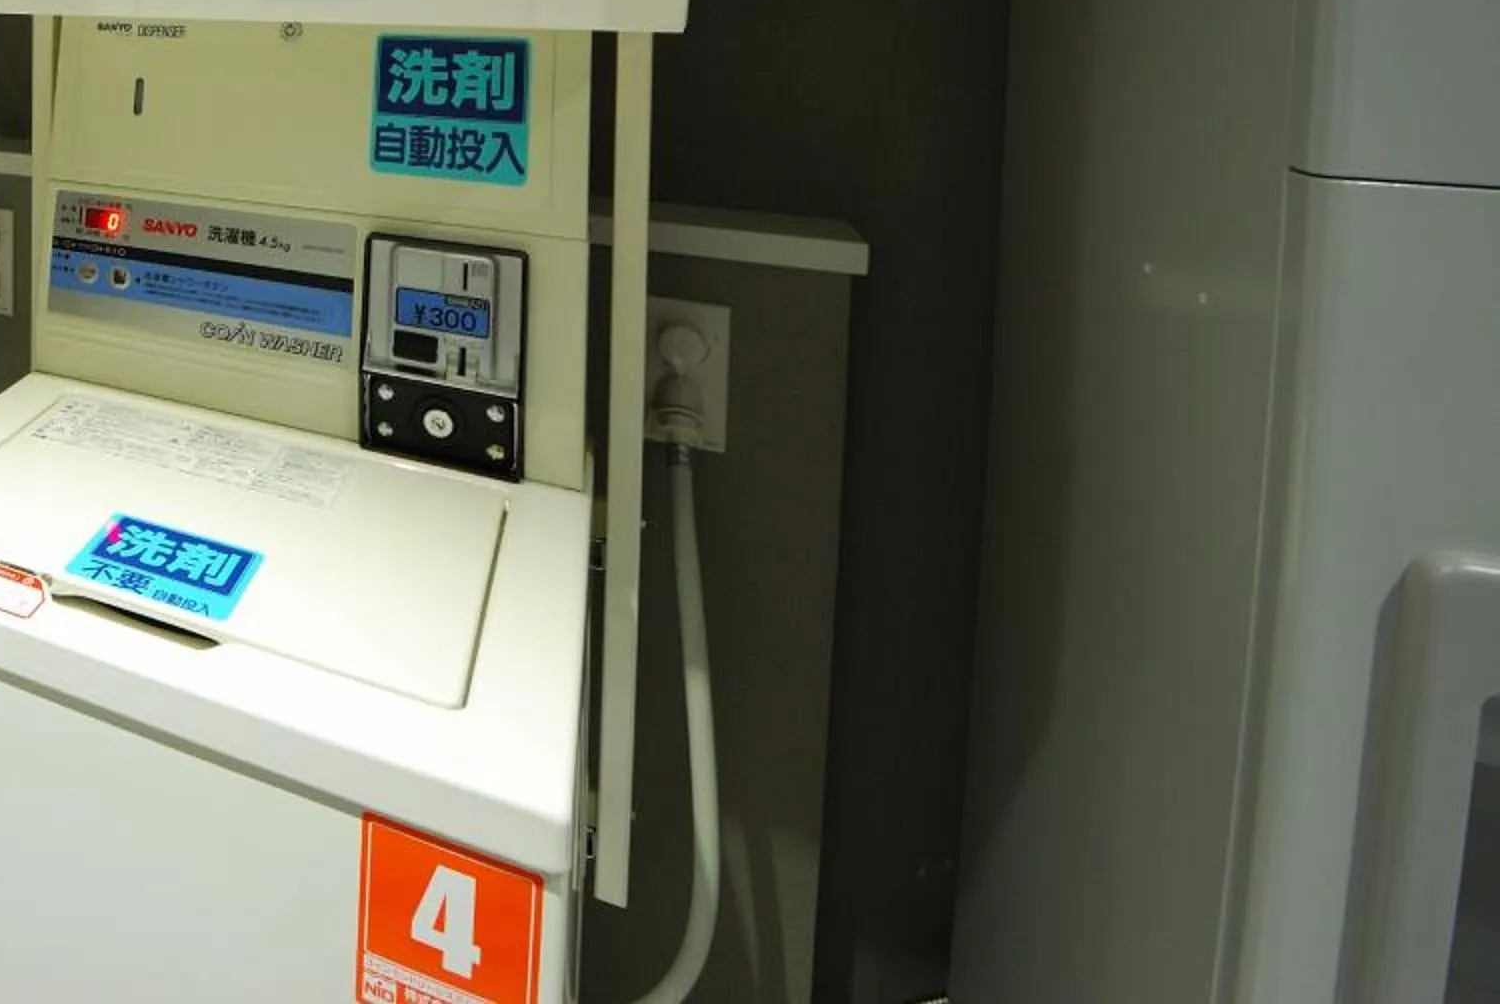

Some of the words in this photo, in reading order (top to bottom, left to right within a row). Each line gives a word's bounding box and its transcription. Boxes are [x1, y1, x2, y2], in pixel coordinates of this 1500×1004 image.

[387, 47, 516, 112] 洗剤
[374, 121, 526, 175] 自動投入
[107, 213, 120, 231] 0
[143, 217, 198, 238] SANYO
[207, 224, 256, 247] 洗濯機
[414, 302, 478, 332] ¥300
[259, 330, 344, 364] WASHER
[106, 524, 242, 588] 洗剤
[82, 559, 154, 596] 不要
[410, 863, 482, 981] 4
